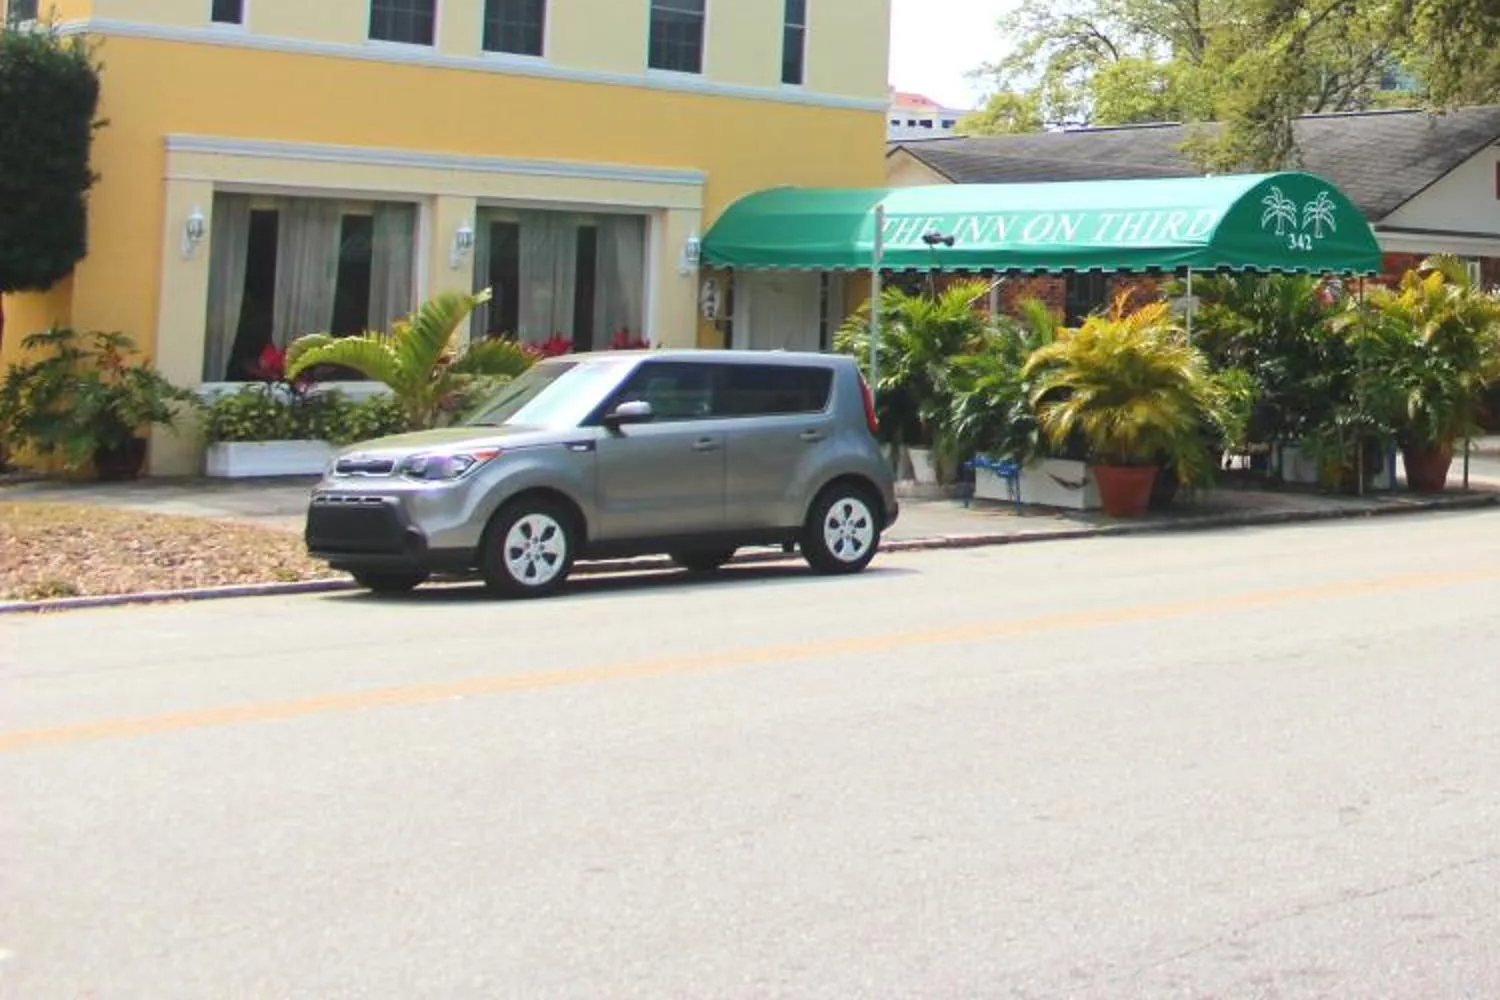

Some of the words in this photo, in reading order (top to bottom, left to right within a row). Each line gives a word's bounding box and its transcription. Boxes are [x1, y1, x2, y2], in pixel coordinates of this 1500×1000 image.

[882, 215, 944, 245] THE
[948, 214, 1019, 245] INN
[1022, 212, 1088, 243] ON
[1093, 208, 1219, 243] THIRD
[1288, 233, 1312, 250] 342
